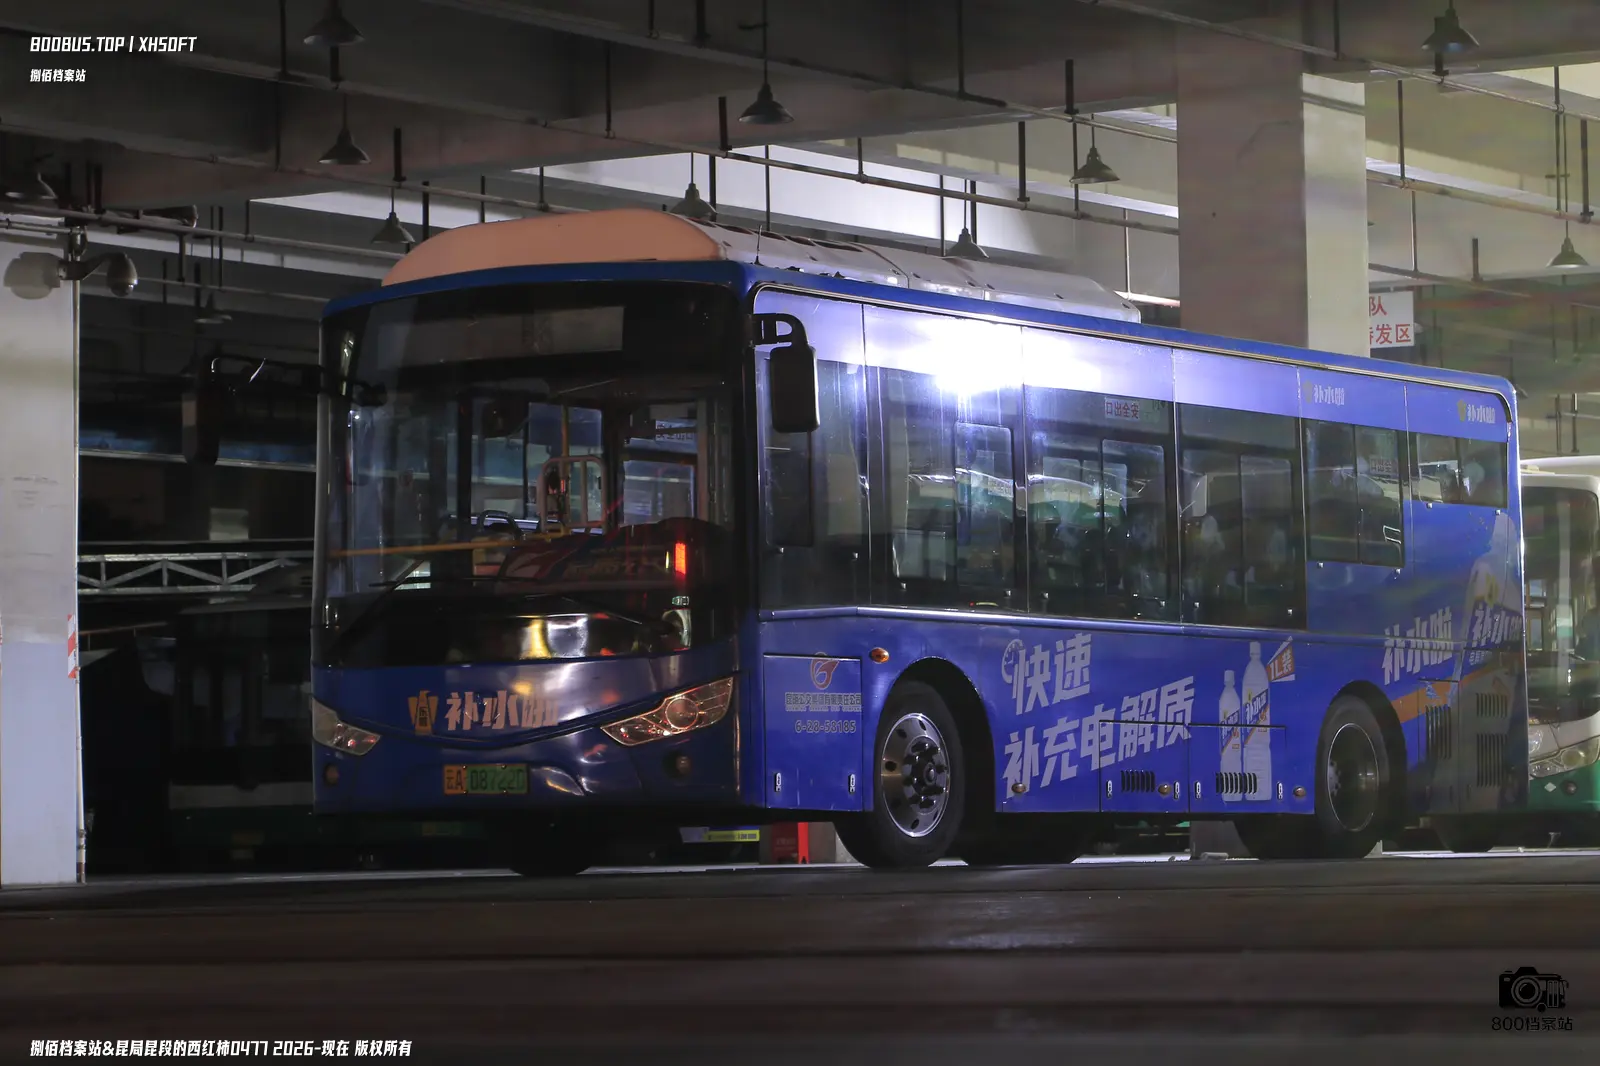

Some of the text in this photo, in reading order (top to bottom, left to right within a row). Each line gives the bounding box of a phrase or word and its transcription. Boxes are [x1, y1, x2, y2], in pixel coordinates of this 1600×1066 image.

[1369, 296, 1387, 317] 队
[1003, 633, 1092, 716] 快速
[1270, 650, 1293, 680] 1L装
[1382, 606, 1452, 685] 补水啦
[445, 690, 559, 731] 补水啦
[1002, 675, 1195, 799] 补充电解质
